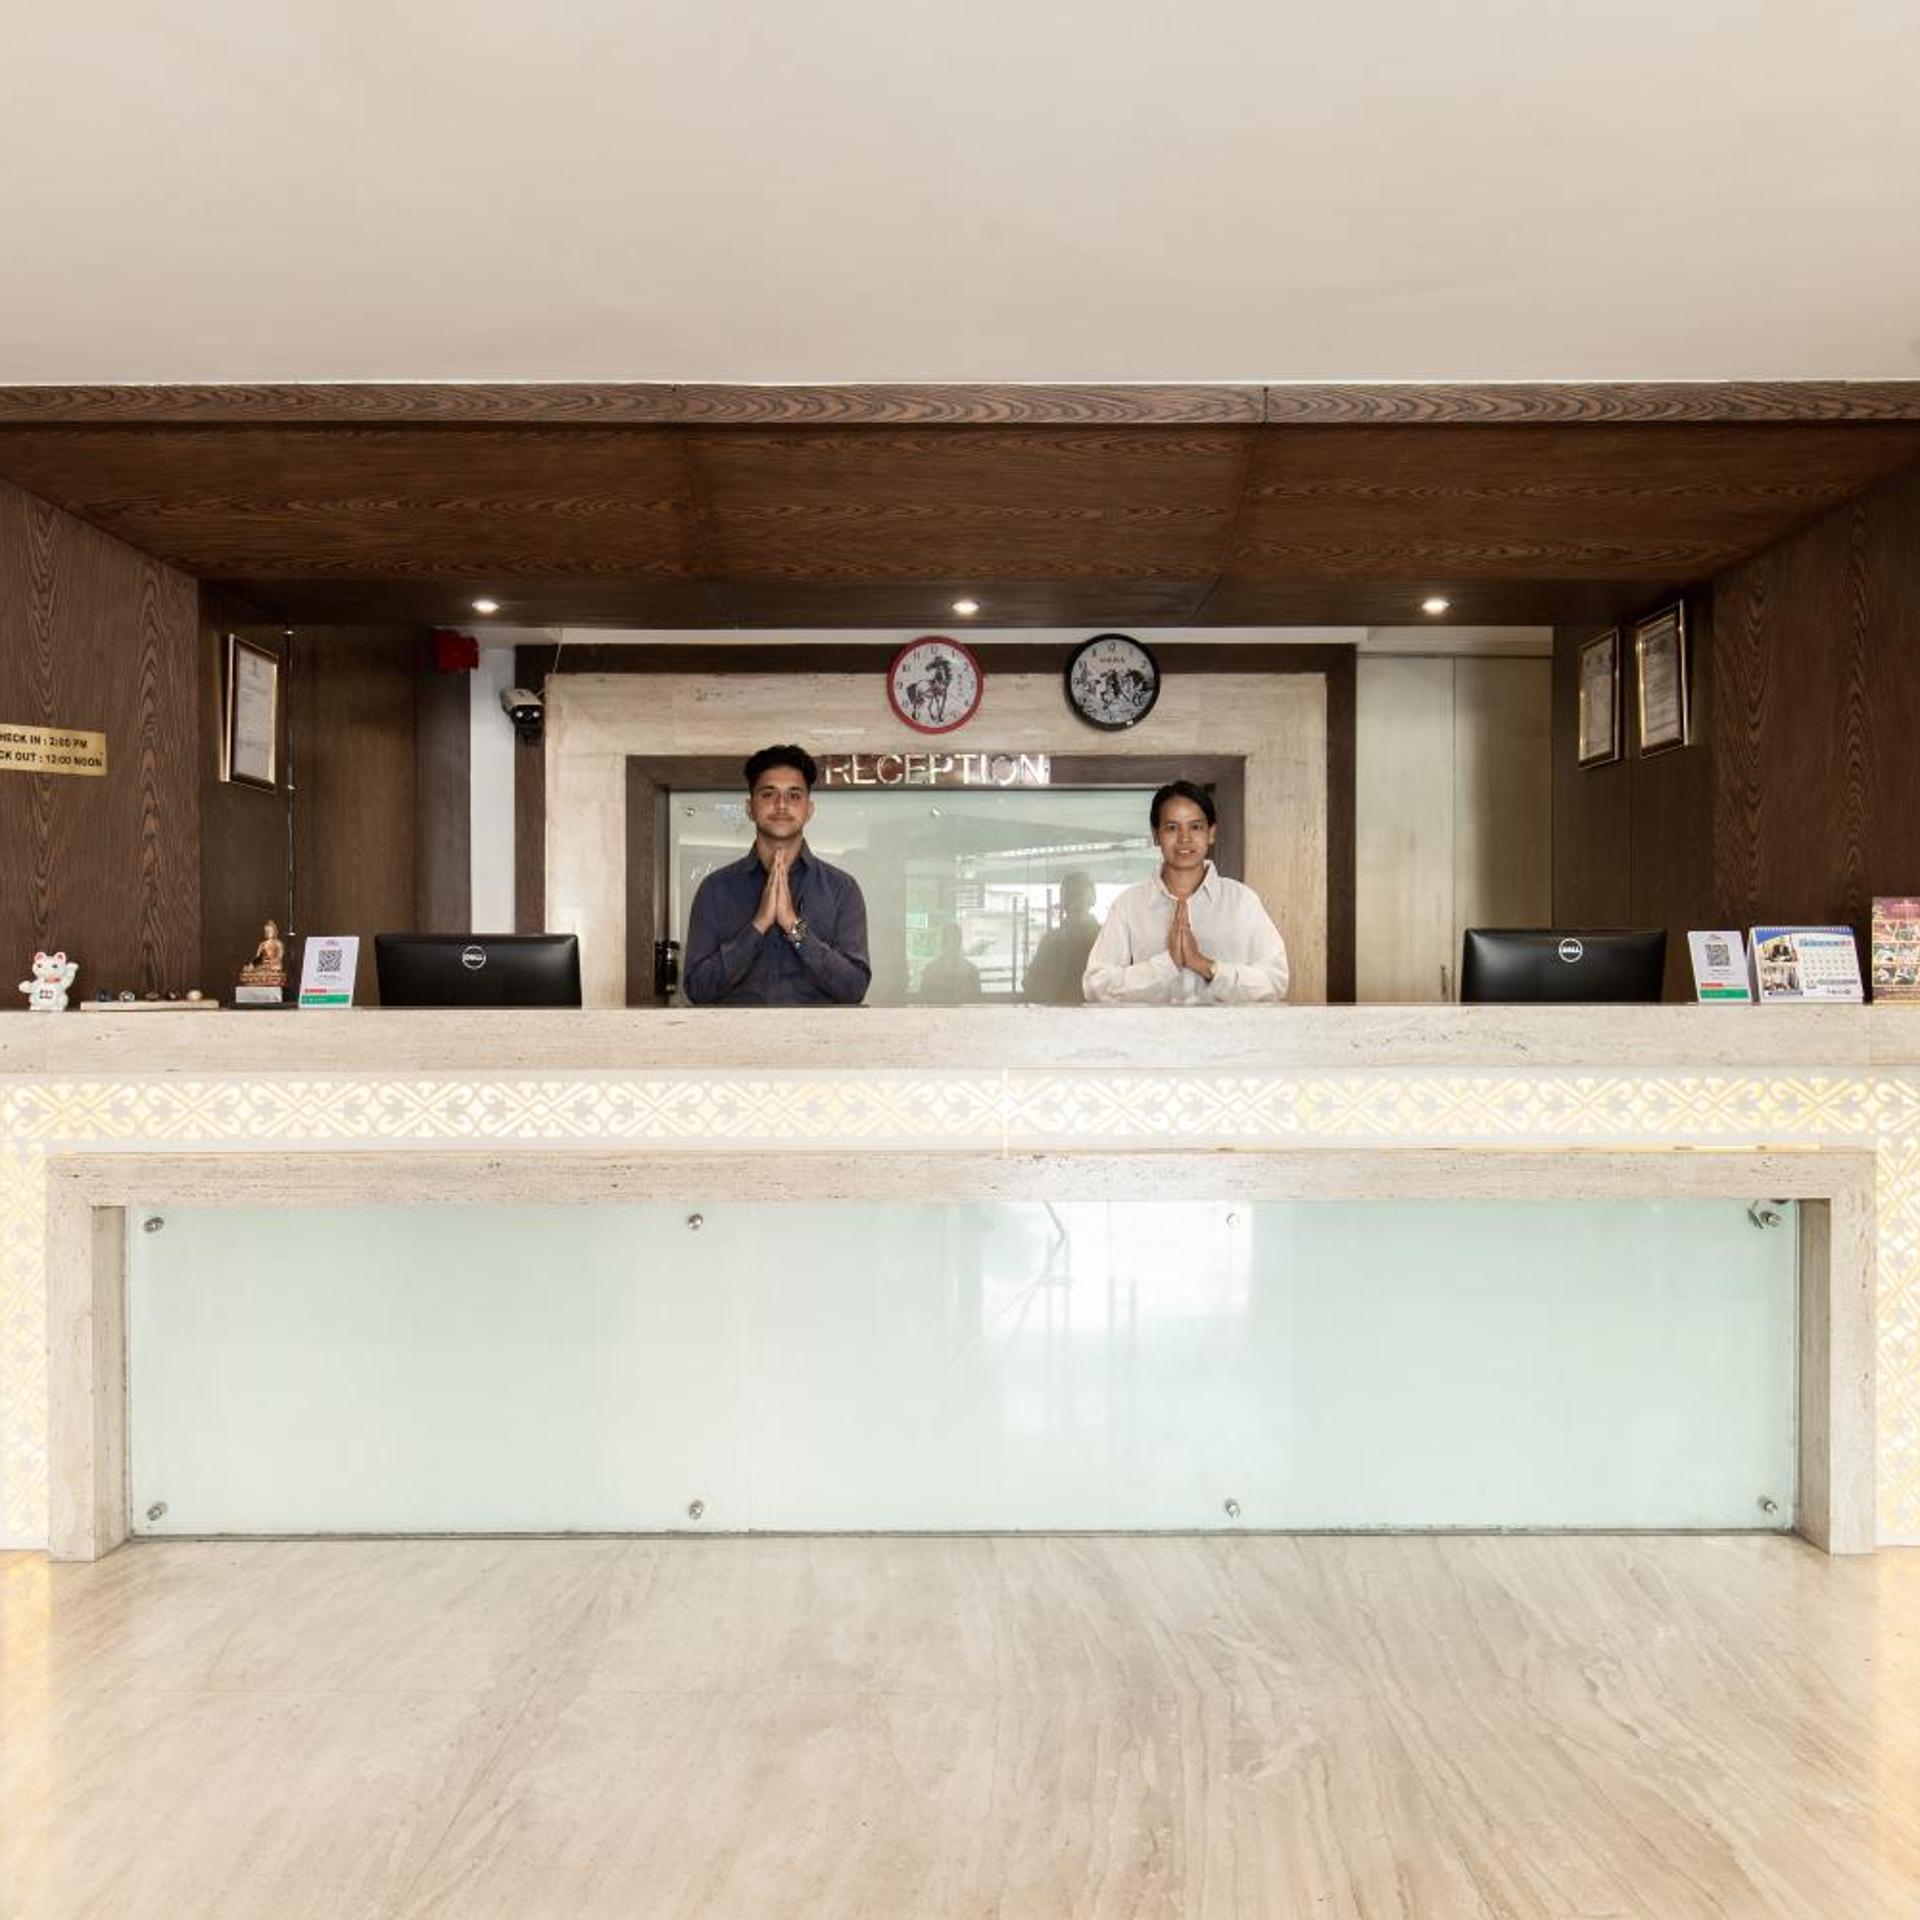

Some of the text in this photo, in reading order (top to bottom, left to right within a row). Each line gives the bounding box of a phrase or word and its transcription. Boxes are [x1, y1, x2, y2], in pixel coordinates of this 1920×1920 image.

[31, 735, 41, 744] IN
[73, 738, 88, 749] PM
[15, 752, 36, 762] OUT
[74, 756, 102, 767] NOON
[824, 754, 1049, 785] RECEPTION
